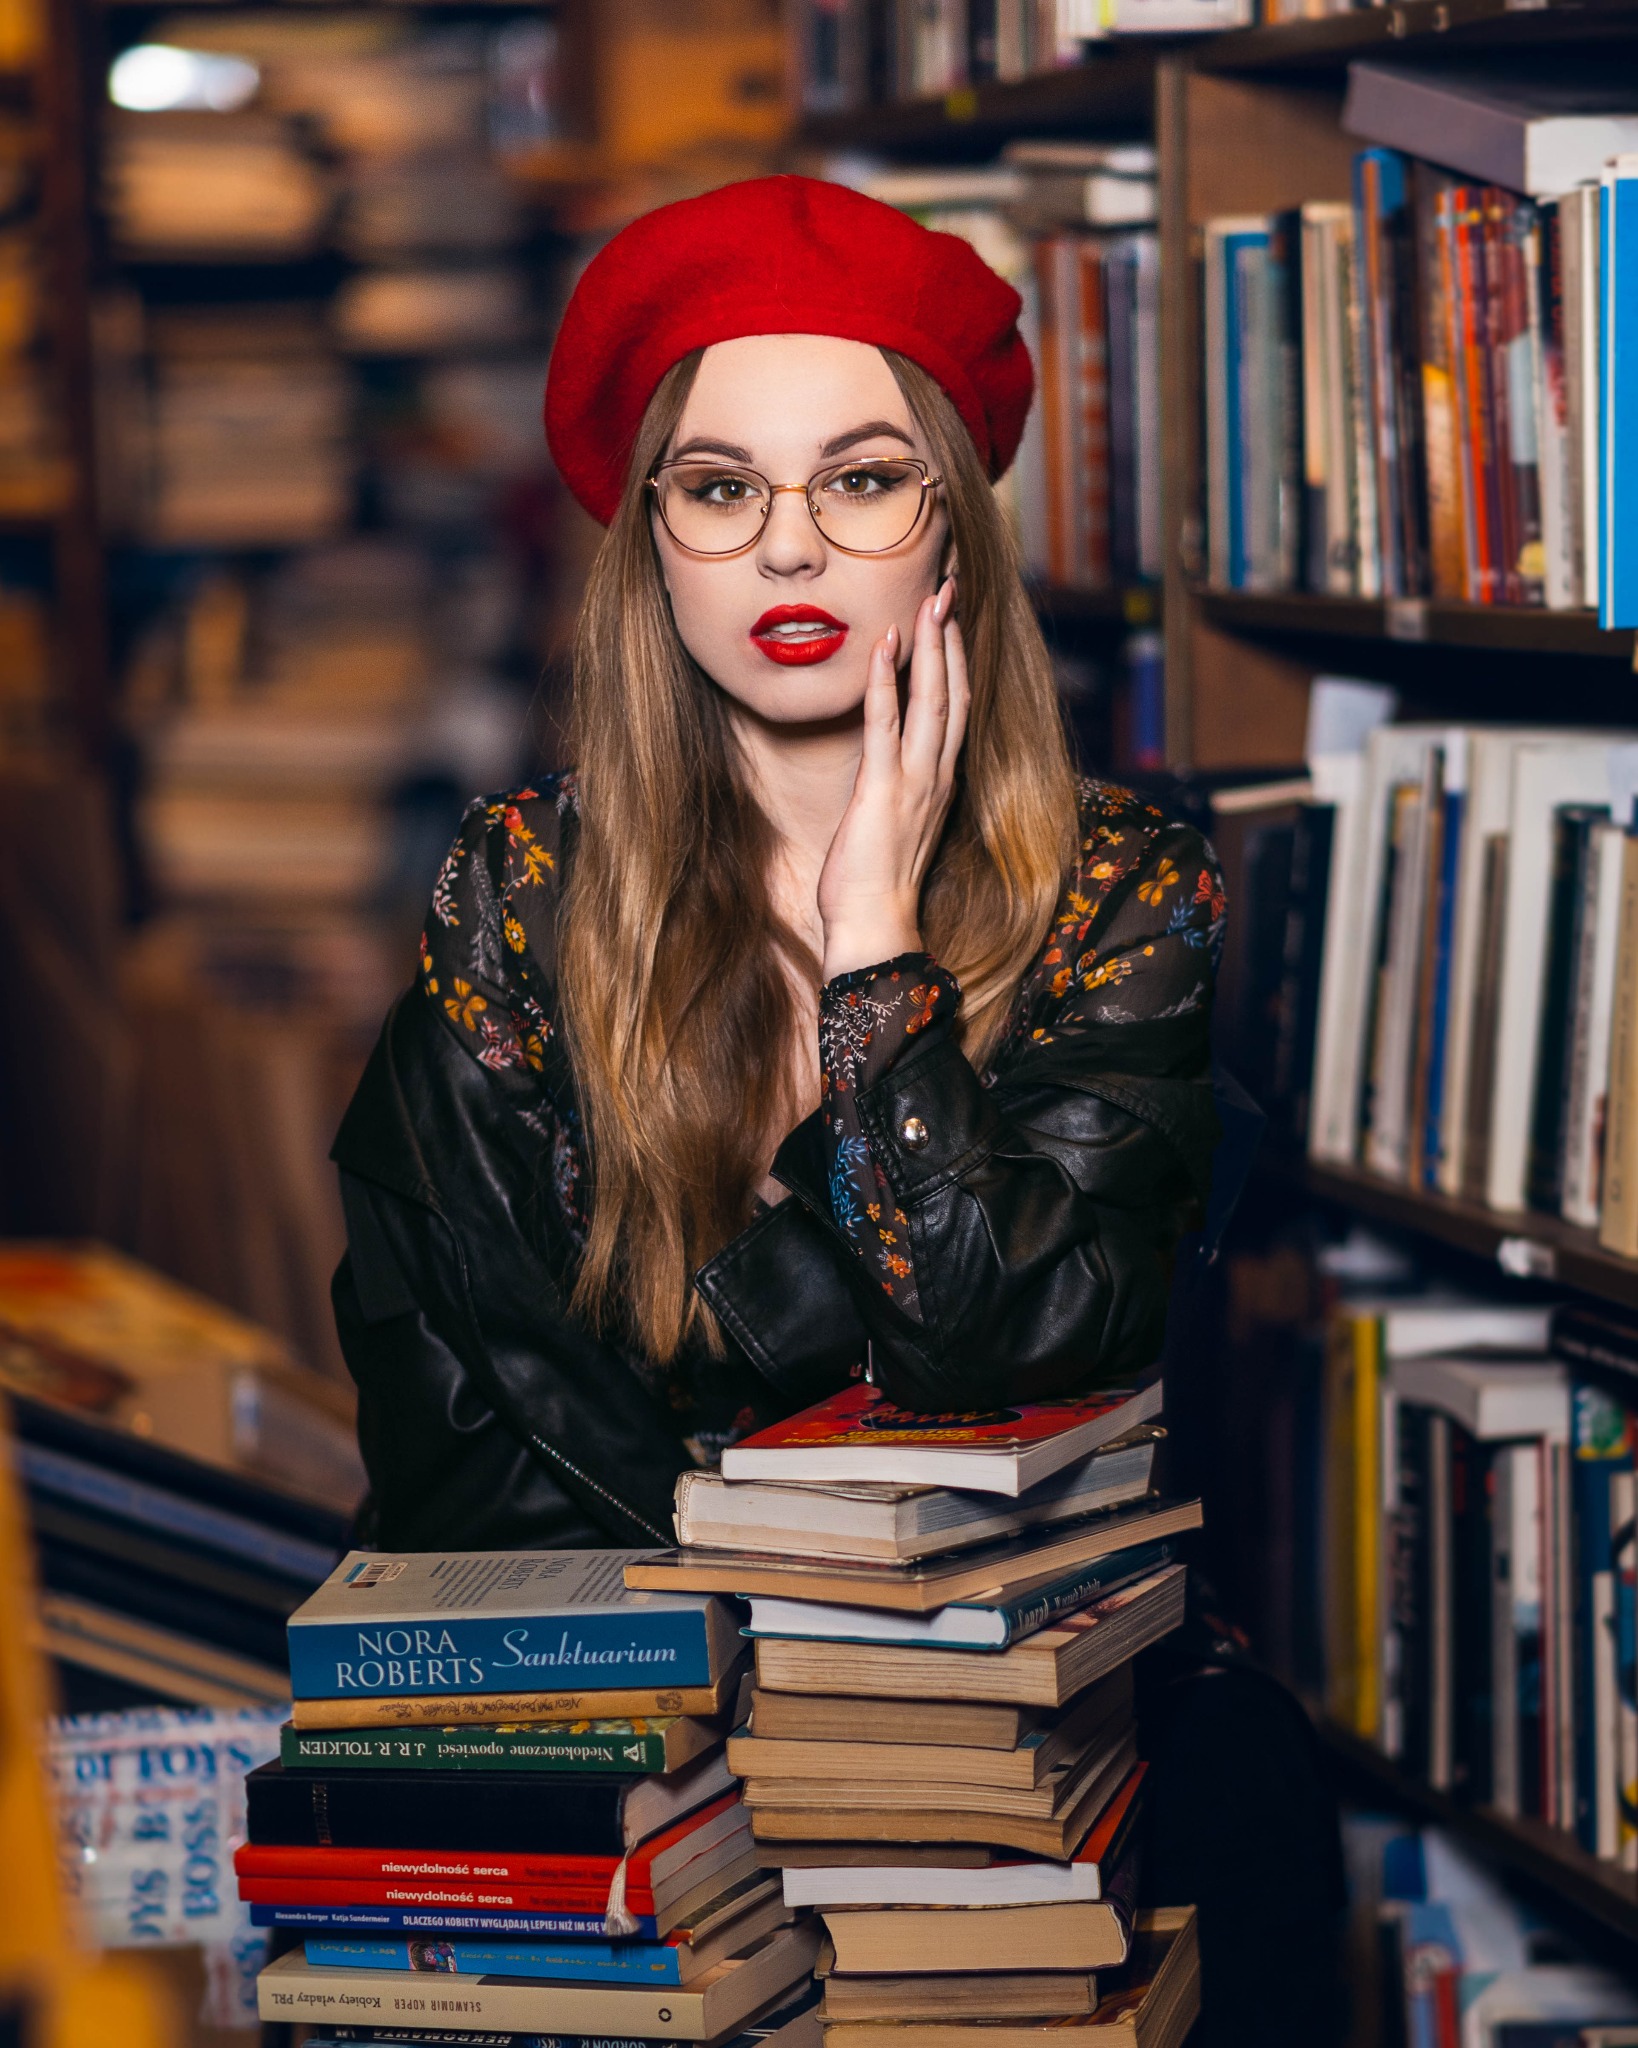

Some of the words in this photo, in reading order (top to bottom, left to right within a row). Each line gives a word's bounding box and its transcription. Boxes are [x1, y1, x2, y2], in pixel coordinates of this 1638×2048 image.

[498, 1558, 547, 1589] ROBERTS
[536, 1557, 575, 1579] NORA
[1018, 1597, 1049, 1631] Conrad
[358, 1629, 458, 1656] NORA
[492, 1629, 677, 1667] Sanktuarium
[336, 1657, 484, 1688] ROBERTS
[299, 1741, 372, 1755] TOLKIEN
[374, 1742, 391, 1756] R.
[394, 1742, 410, 1756] R.
[414, 1743, 426, 1756] J.
[437, 1741, 504, 1758] opowieści
[510, 1745, 614, 1761] Niedokończone
[381, 1862, 470, 1875] niewydolność
[473, 1866, 509, 1876] serca
[386, 1889, 474, 1902] niewydolność
[478, 1893, 513, 1904] serca
[275, 1912, 306, 1920] Alexandra
[307, 1912, 328, 1922] Berger
[331, 1914, 349, 1922] Katja
[349, 1914, 390, 1923] Sundermeier
[403, 1915, 443, 1926] DLACZEGO
[444, 1917, 479, 1928] KOBIETY
[480, 1918, 530, 1932] WYGLĄDAJĄ
[530, 1919, 557, 1930] LEPIEJ
[558, 1919, 573, 1931] NIŻ
[574, 1922, 585, 1931] IM
[586, 1922, 600, 1933] SIĘ
[271, 1993, 294, 2005] PRL
[297, 1992, 335, 2007] władzy
[339, 1994, 381, 2008] Kobiety
[394, 1998, 426, 2010] KOPER
[431, 2000, 482, 2012] SŁAWOMIR
[373, 2029, 512, 2045] NEKROMANTA
